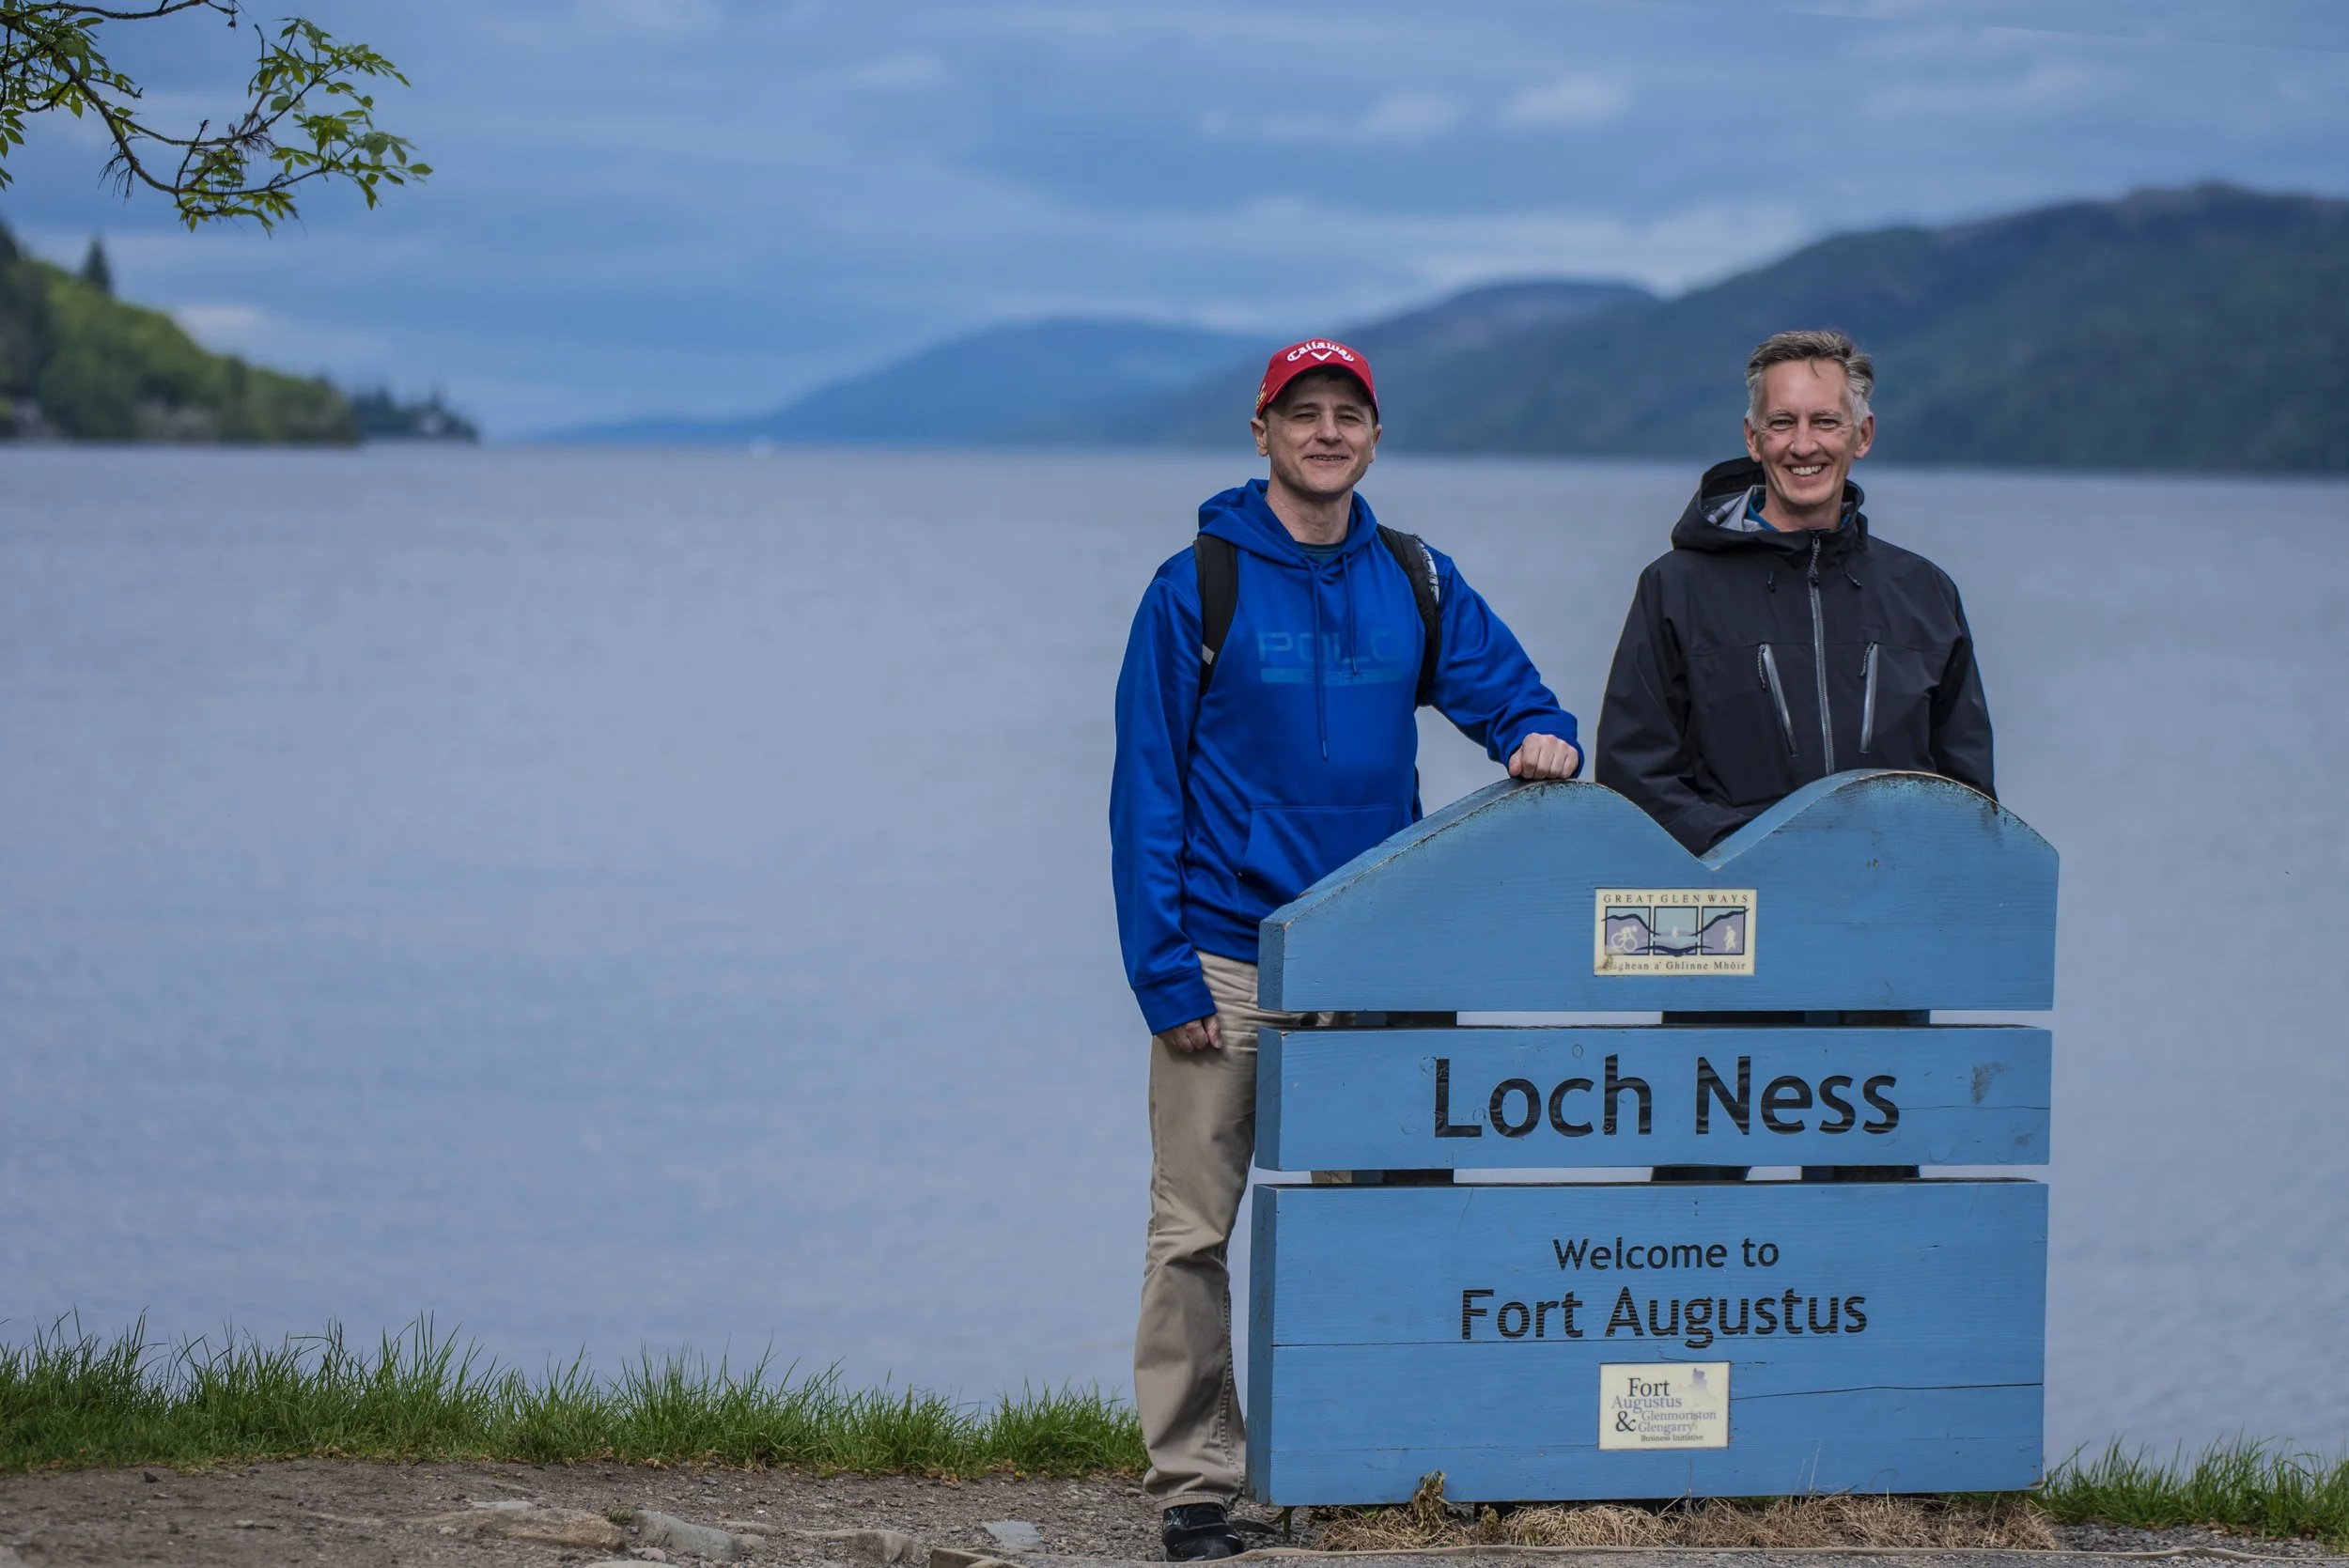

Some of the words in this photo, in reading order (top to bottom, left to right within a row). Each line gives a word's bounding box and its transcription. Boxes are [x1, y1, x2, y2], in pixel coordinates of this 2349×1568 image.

[1287, 341, 1354, 362] Callaway
[1258, 631, 1402, 663] POLO
[1604, 894, 1654, 904] GREAT
[1660, 894, 1701, 904] GLEN
[1707, 894, 1749, 904] WAYS
[1666, 960, 1708, 970] Ghlinne
[1714, 960, 1747, 970] Mhòir
[1435, 1053, 1652, 1139] Loch
[1695, 1055, 1900, 1136] Ness
[1552, 1236, 1728, 1271] Welcome
[1741, 1237, 1780, 1267] to
[1462, 1288, 1584, 1340] Fort
[1605, 1285, 1868, 1349] Augustus
[1627, 1377, 1671, 1397] Fort
[1610, 1395, 1683, 1413] Augustus
[1615, 1410, 1637, 1433] &
[1638, 1421, 1695, 1436] Glengarry
[1641, 1410, 1717, 1421] Glenmoriston
